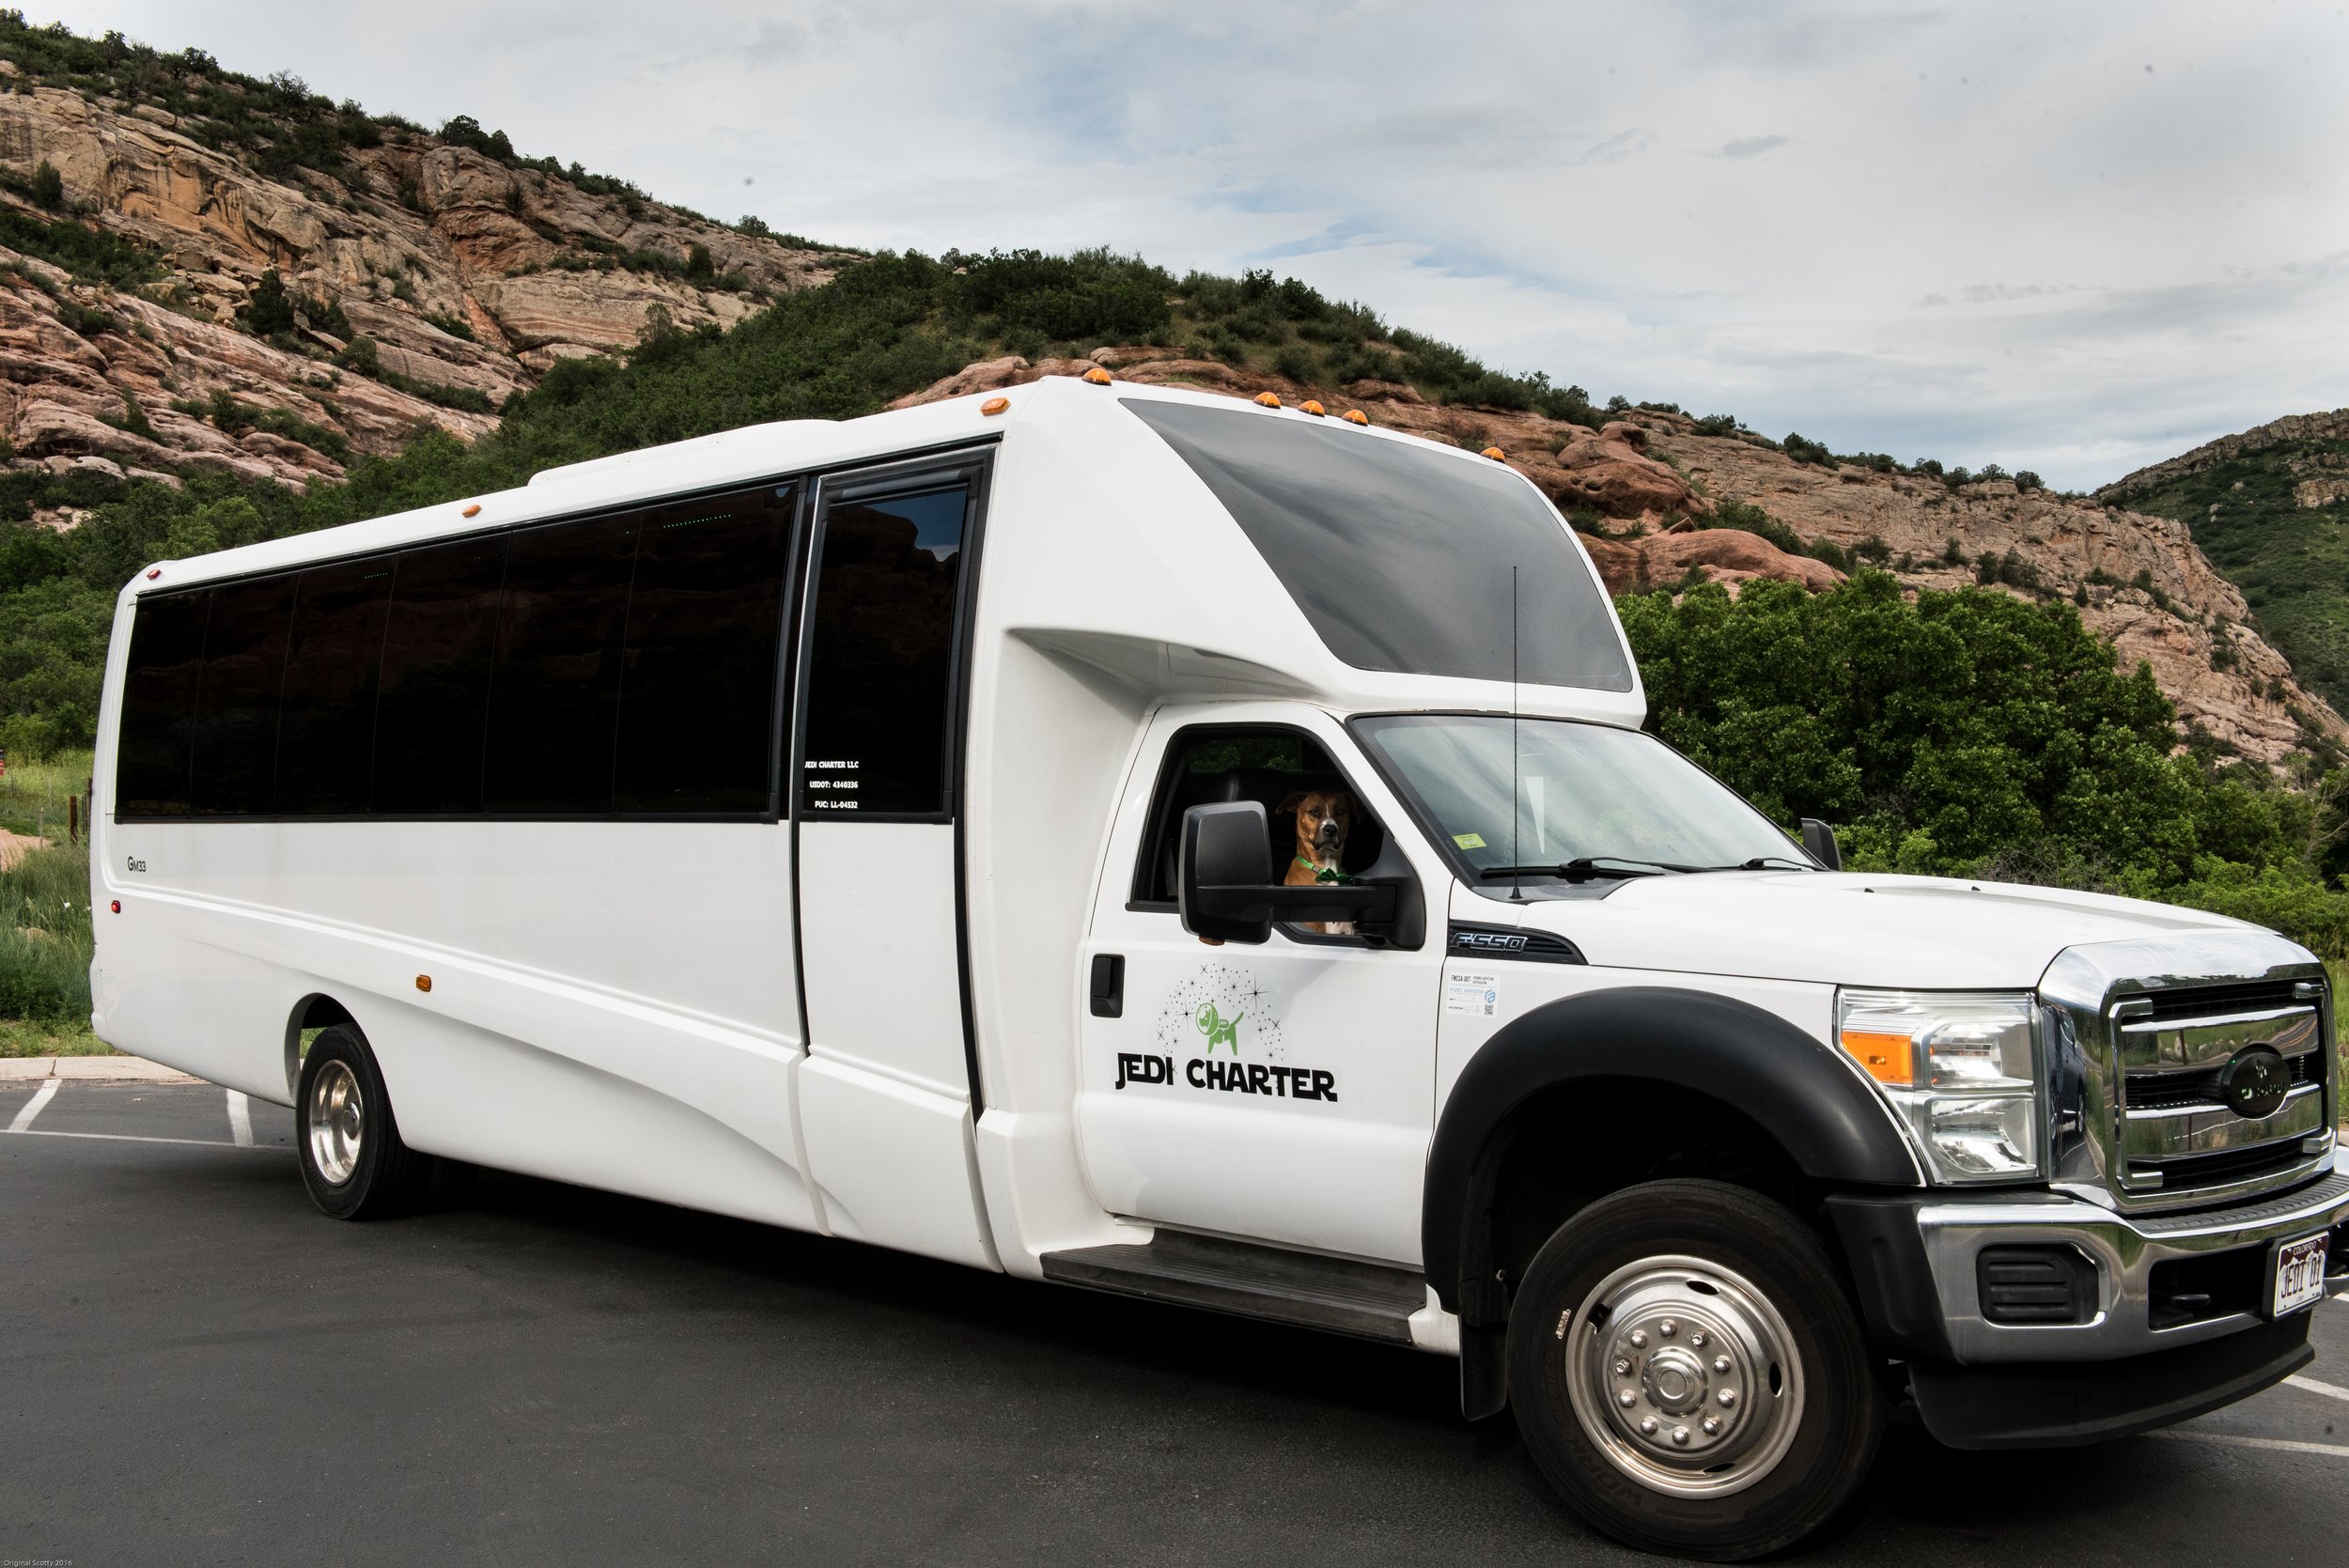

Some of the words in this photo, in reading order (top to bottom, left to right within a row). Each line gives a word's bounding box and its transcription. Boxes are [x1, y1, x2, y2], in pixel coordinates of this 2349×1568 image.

[804, 760, 817, 768] JEDI
[818, 760, 846, 768] CHARTER
[847, 760, 859, 768] LLC
[127, 855, 147, 873] GM33
[1450, 932, 1529, 953] F-550
[1115, 1052, 1174, 1090] JEDI
[1186, 1058, 1338, 1102] CHARTER
[2293, 1240, 2317, 1256] COLORADO
